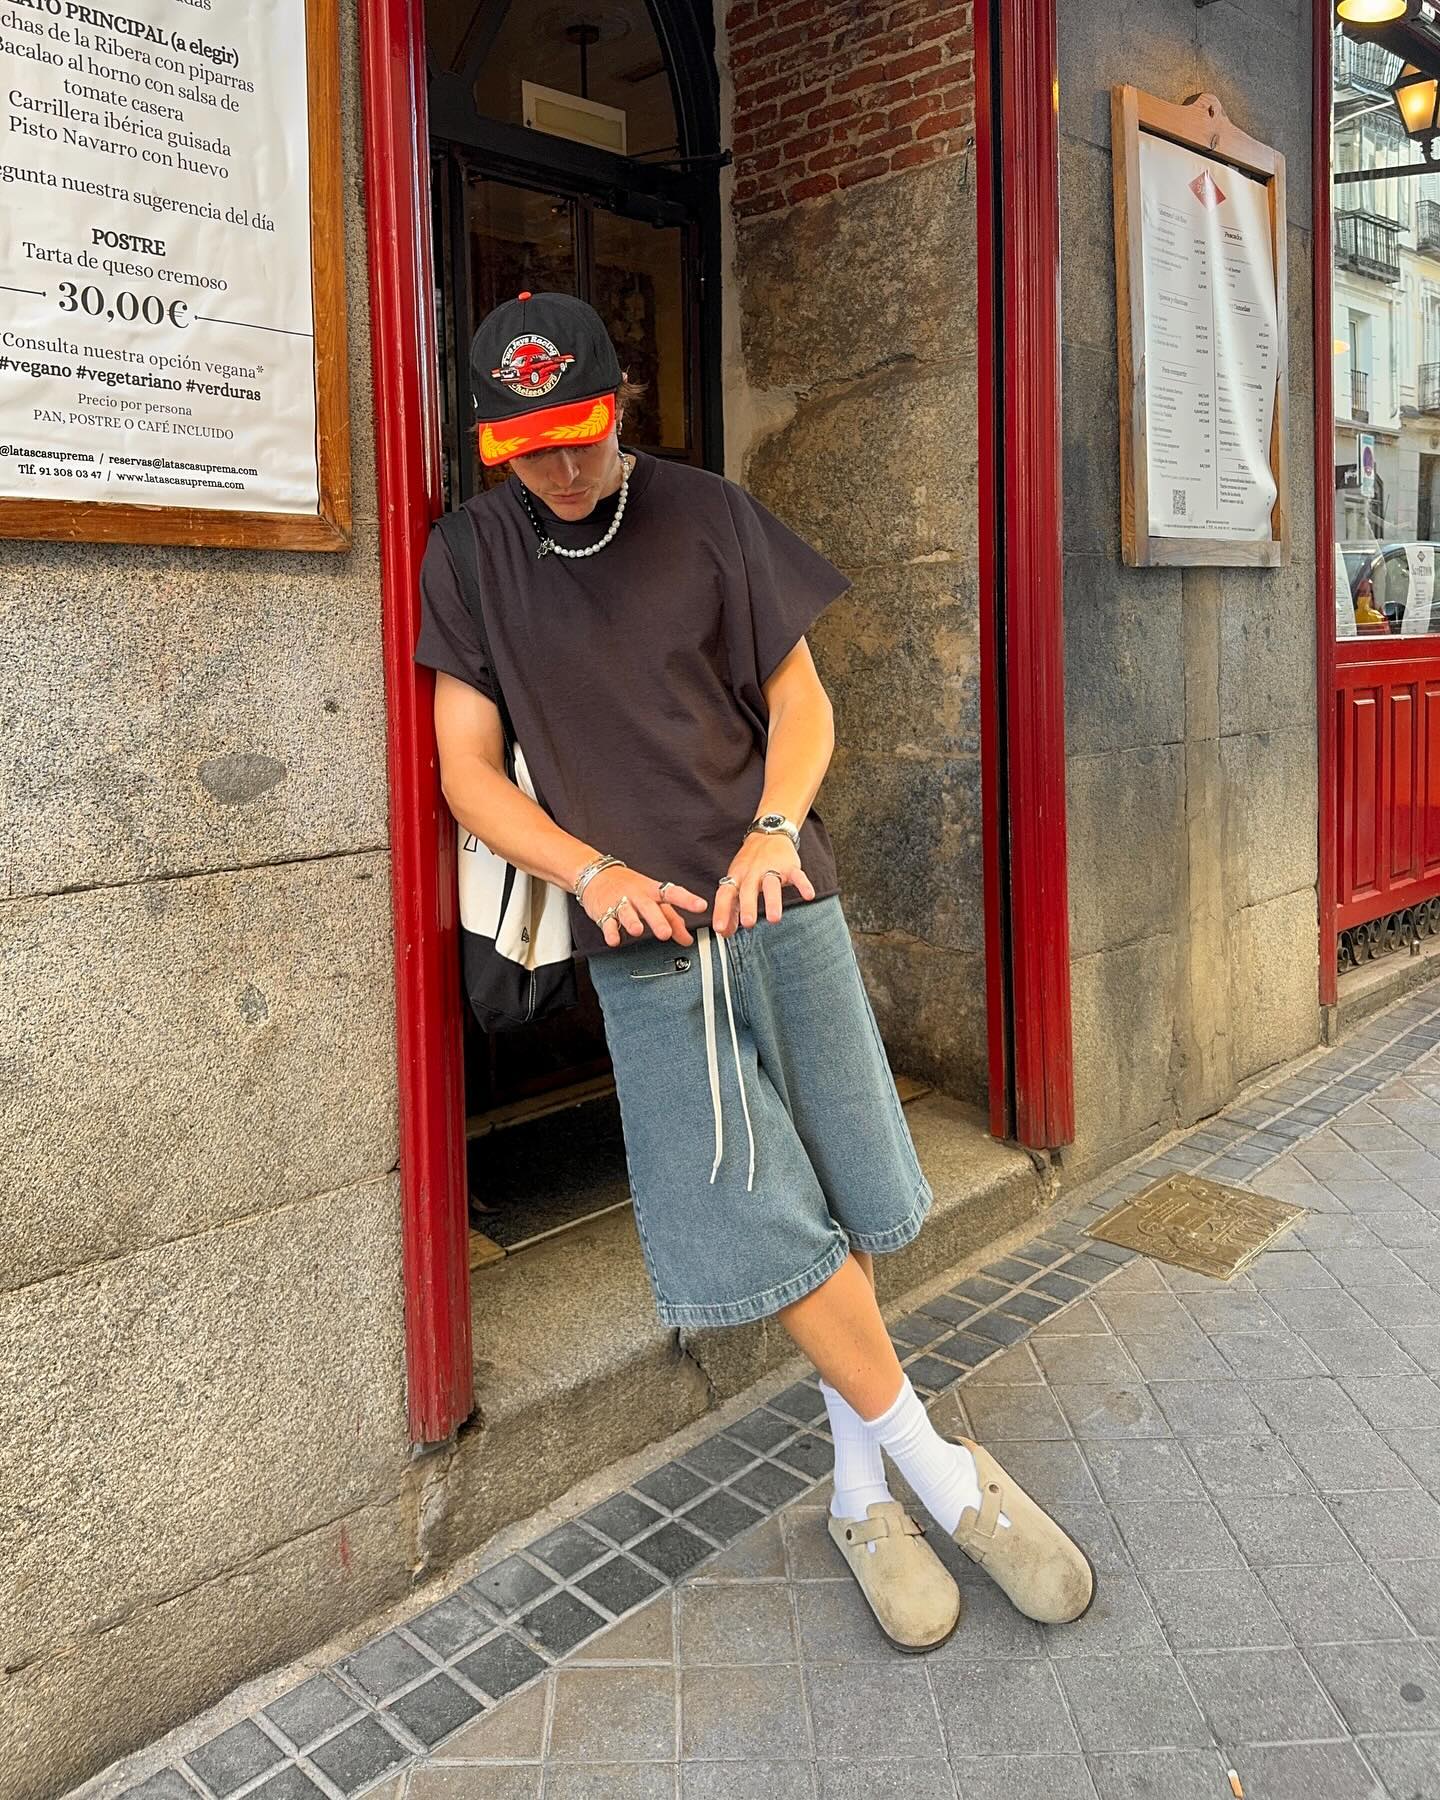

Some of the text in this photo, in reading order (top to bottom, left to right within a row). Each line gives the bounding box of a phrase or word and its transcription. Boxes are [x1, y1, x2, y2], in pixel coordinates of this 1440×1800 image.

[64, 1, 169, 49] PRINCIPAL
[170, 31, 187, 55] (a
[189, 38, 239, 69] elegir)
[47, 22, 71, 43] de
[73, 27, 91, 49] la
[93, 37, 154, 66] Ribera
[154, 56, 186, 75] con
[187, 65, 255, 95] piparras
[63, 78, 184, 124] tomate casera
[68, 53, 84, 73] al
[86, 56, 141, 88] horno
[144, 77, 175, 97] con
[178, 84, 219, 107] salsa
[220, 92, 240, 112] de
[9, 90, 231, 157] Carrillera ibérica guisada
[9, 114, 229, 179] Pisto Navarro con huevo
[0, 165, 275, 232] gunta nuestra sugerencia del día
[91, 228, 166, 257] POSTRE
[22, 241, 228, 291] Tarta de queso cremoso
[58, 281, 189, 329] 30,00€
[0, 332, 79, 356] Consulta
[83, 346, 145, 364] nuestra
[148, 354, 202, 377] opción
[503, 347, 513, 365] Two
[530, 336, 558, 357] Racing
[0, 357, 261, 401] #vegano #vegetariano #verduras
[33, 409, 234, 440] PAN, POSTRE O CAFÉ INCLUIDO
[78, 392, 192, 418] Precio por persona
[0, 444, 258, 476] @latascasuprema / reservas@latascasuprema.com
[17, 463, 245, 490] Tlf. 91 308 03 47 / www.latascasuprema.com
